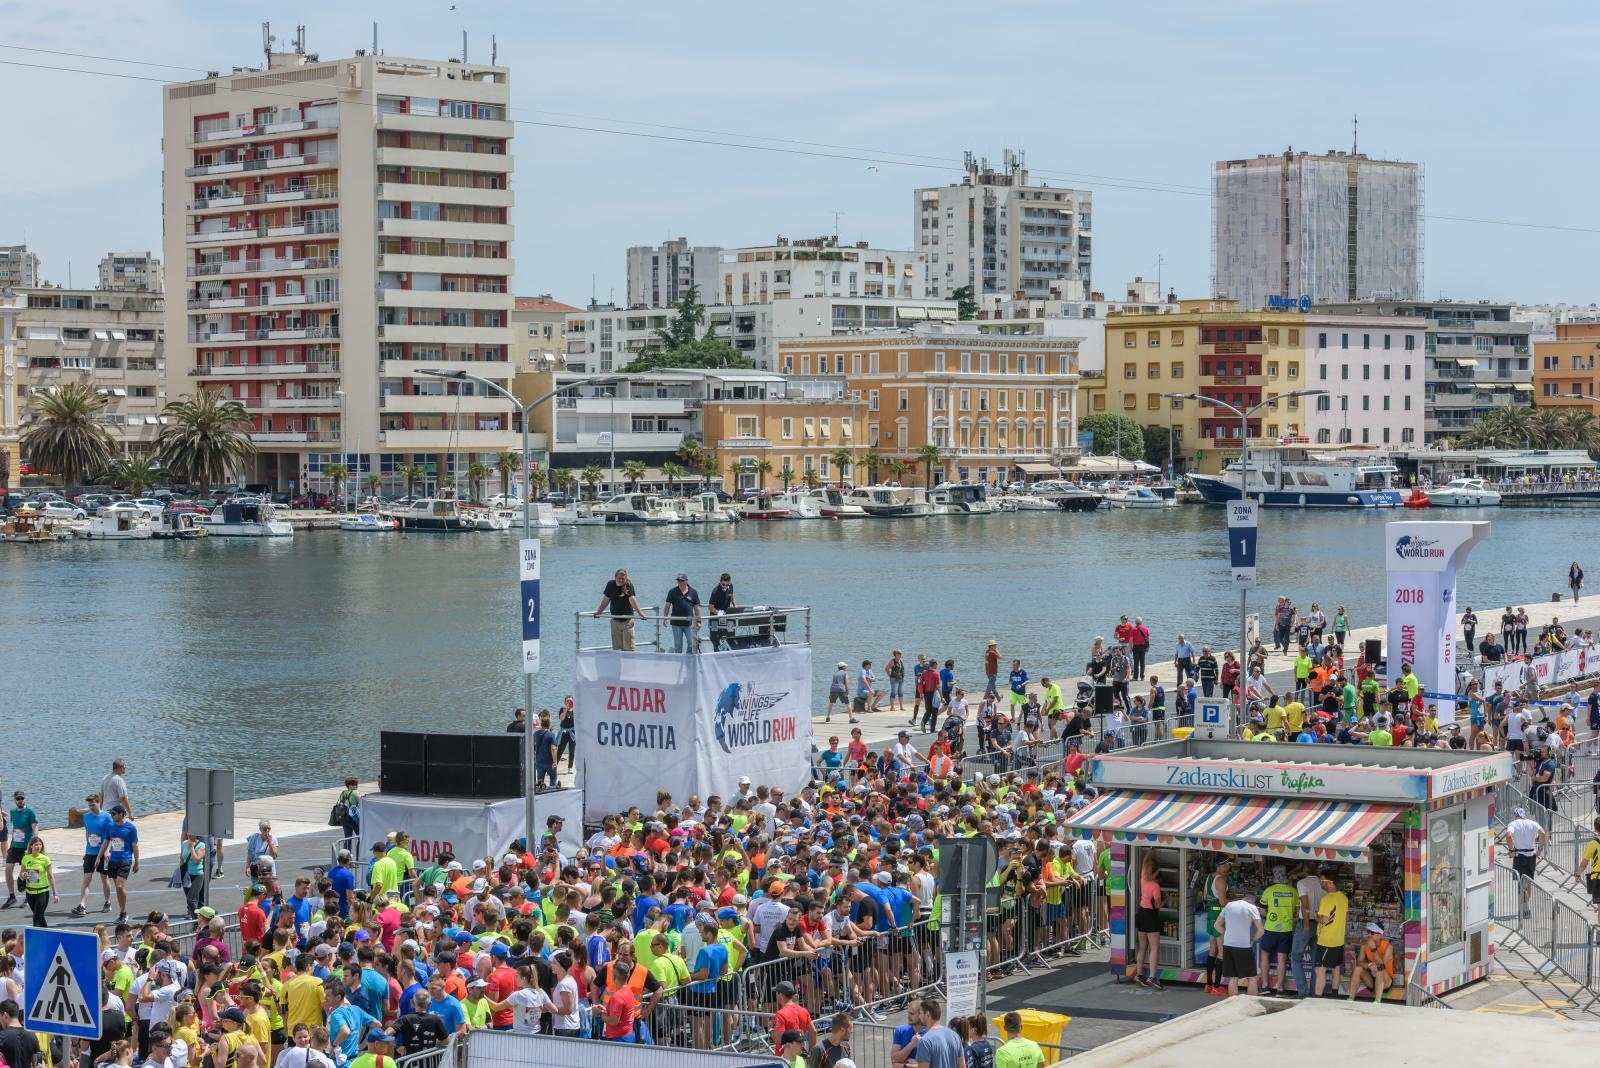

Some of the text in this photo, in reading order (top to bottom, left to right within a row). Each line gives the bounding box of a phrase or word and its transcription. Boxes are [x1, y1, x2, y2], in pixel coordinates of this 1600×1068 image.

[1234, 506, 1252, 515] ZONA
[524, 549, 537, 561] ZONA
[1240, 538, 1247, 556] 1
[1403, 548, 1445, 558] WORLD RUN
[1395, 588, 1424, 604] 2018
[528, 598, 535, 622] 2
[1401, 624, 1415, 665] ZADAR
[606, 686, 666, 713] ZADAR
[740, 696, 770, 710] WINGS
[597, 721, 676, 750] CROATIA
[728, 716, 795, 748] WORLD RUN
[1281, 769, 1325, 792] trafika
